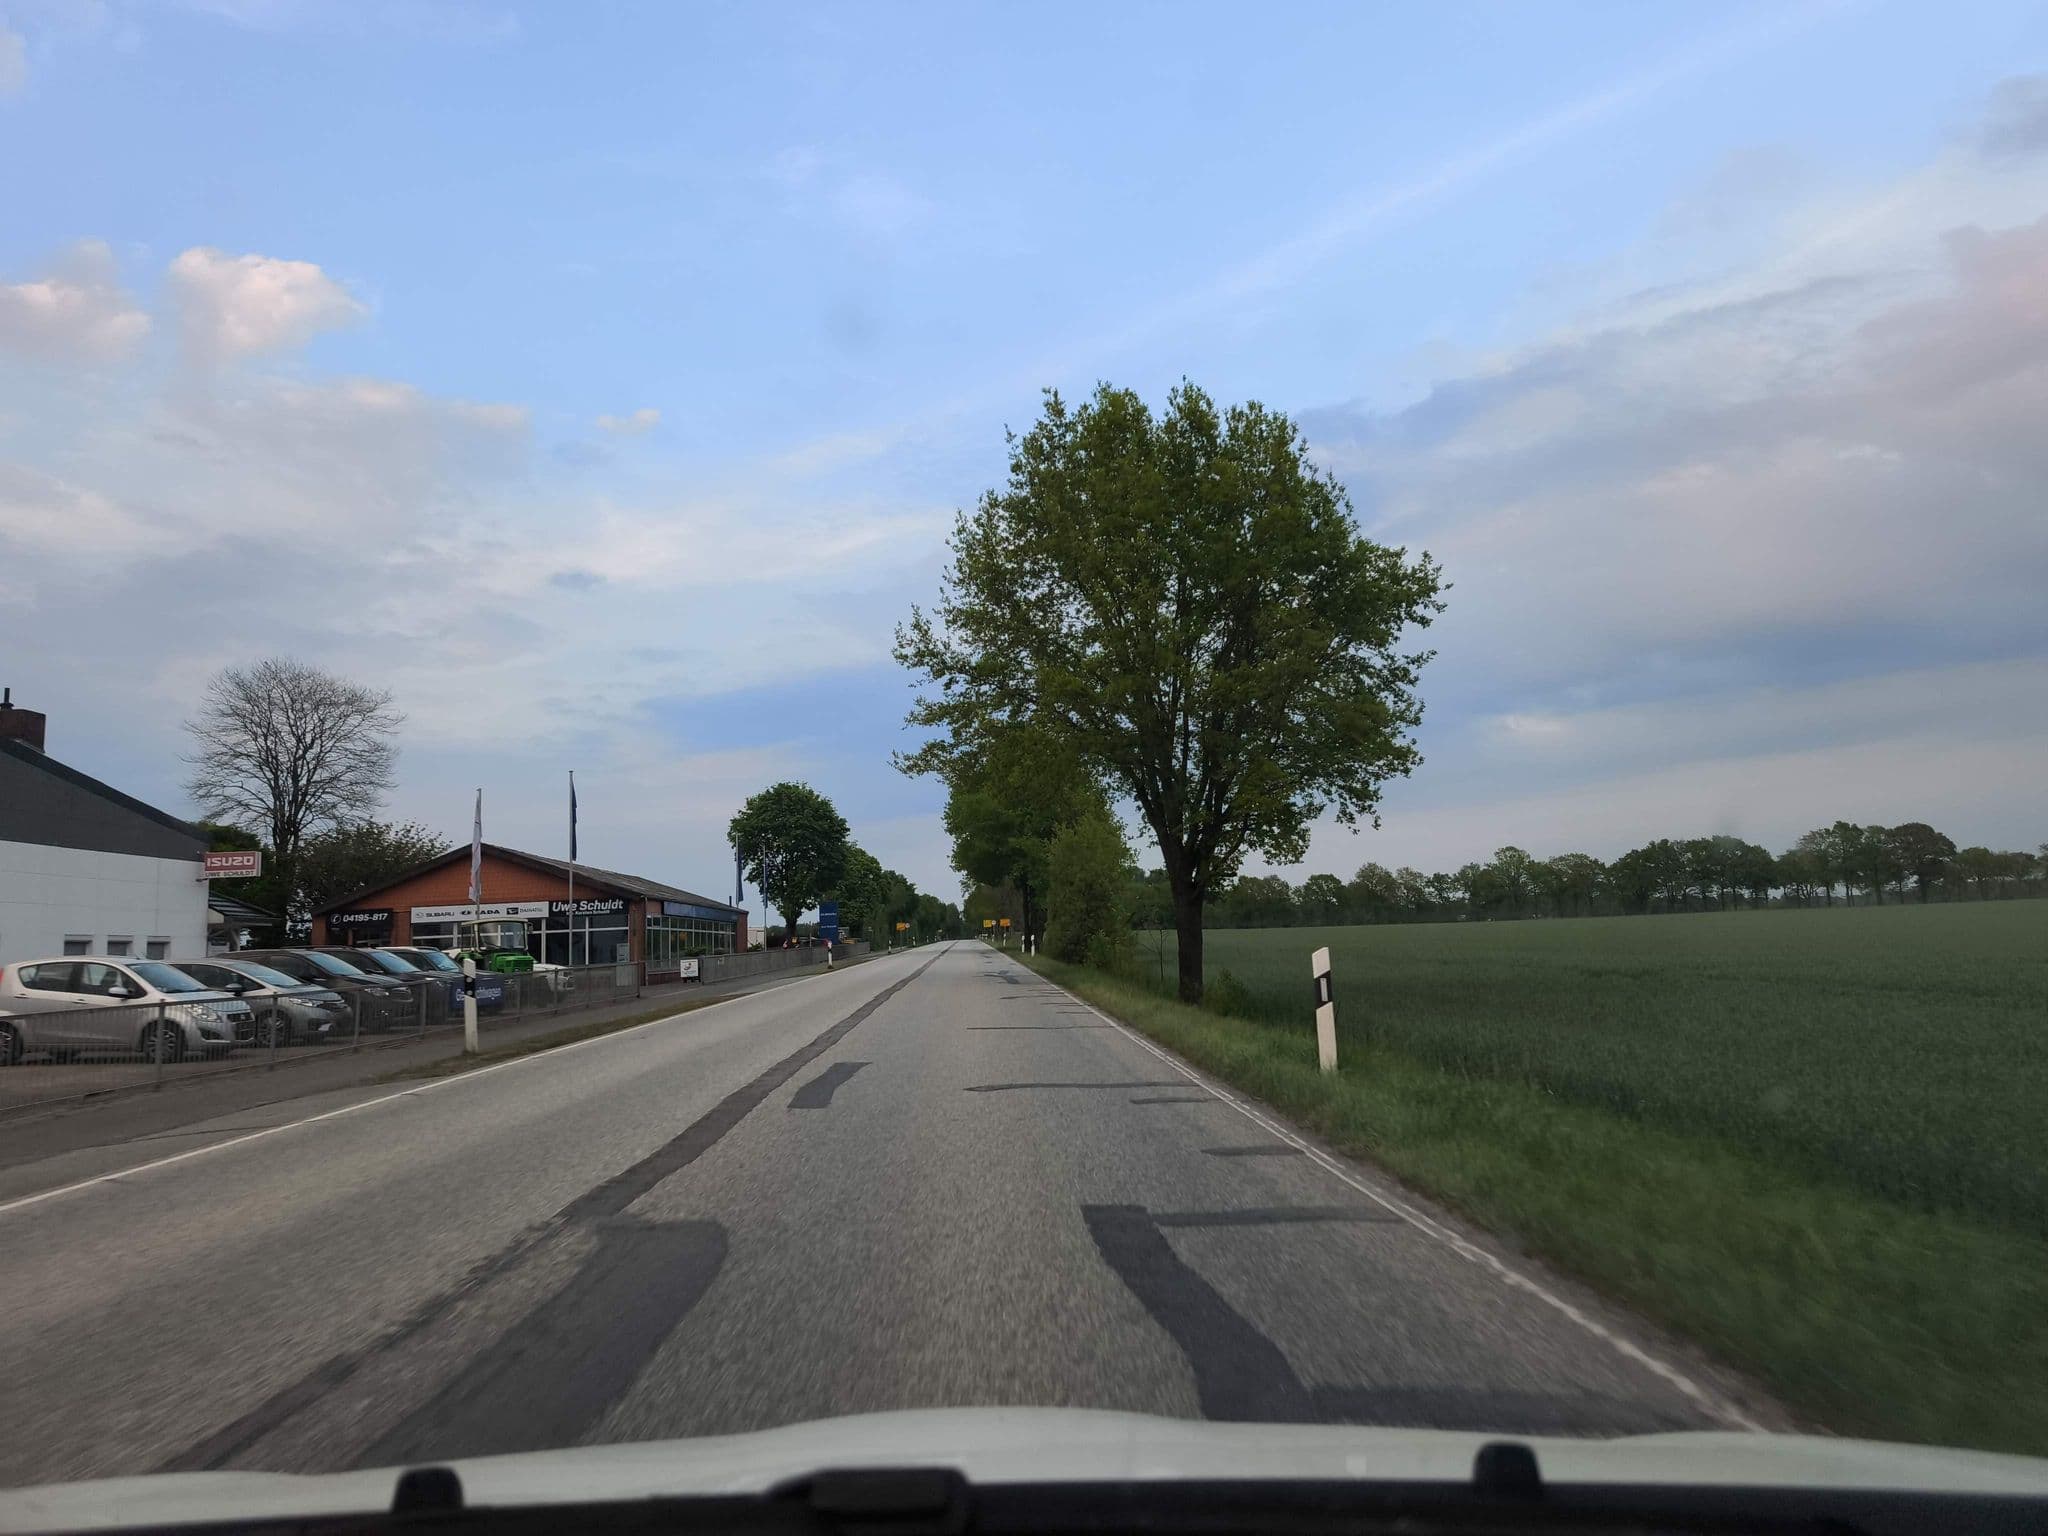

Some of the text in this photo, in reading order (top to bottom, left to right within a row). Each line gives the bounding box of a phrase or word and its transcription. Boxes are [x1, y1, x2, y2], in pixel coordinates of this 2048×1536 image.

[552, 899, 624, 912] Uwe Schuldt
[342, 913, 389, 922] 04195-817
